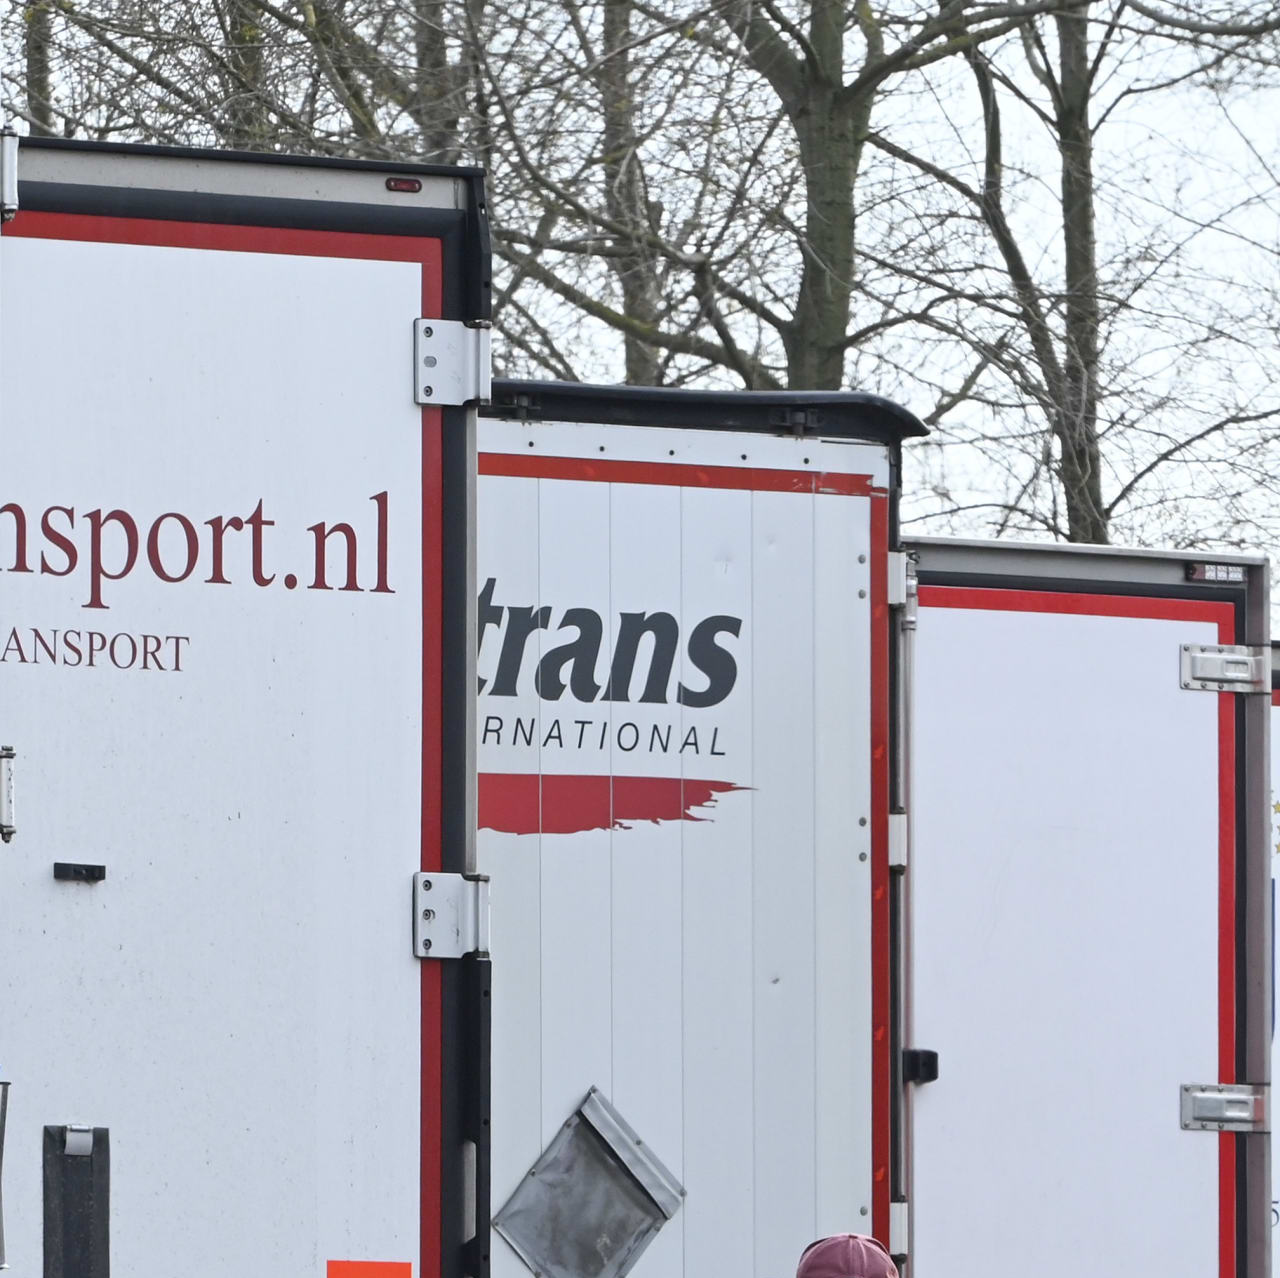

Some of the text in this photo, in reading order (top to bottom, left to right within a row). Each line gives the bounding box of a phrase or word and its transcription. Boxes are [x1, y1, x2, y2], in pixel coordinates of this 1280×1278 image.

[1, 627, 191, 674] ANSPORT
[478, 577, 743, 708] trans
[481, 715, 726, 756] RNATIONAL
